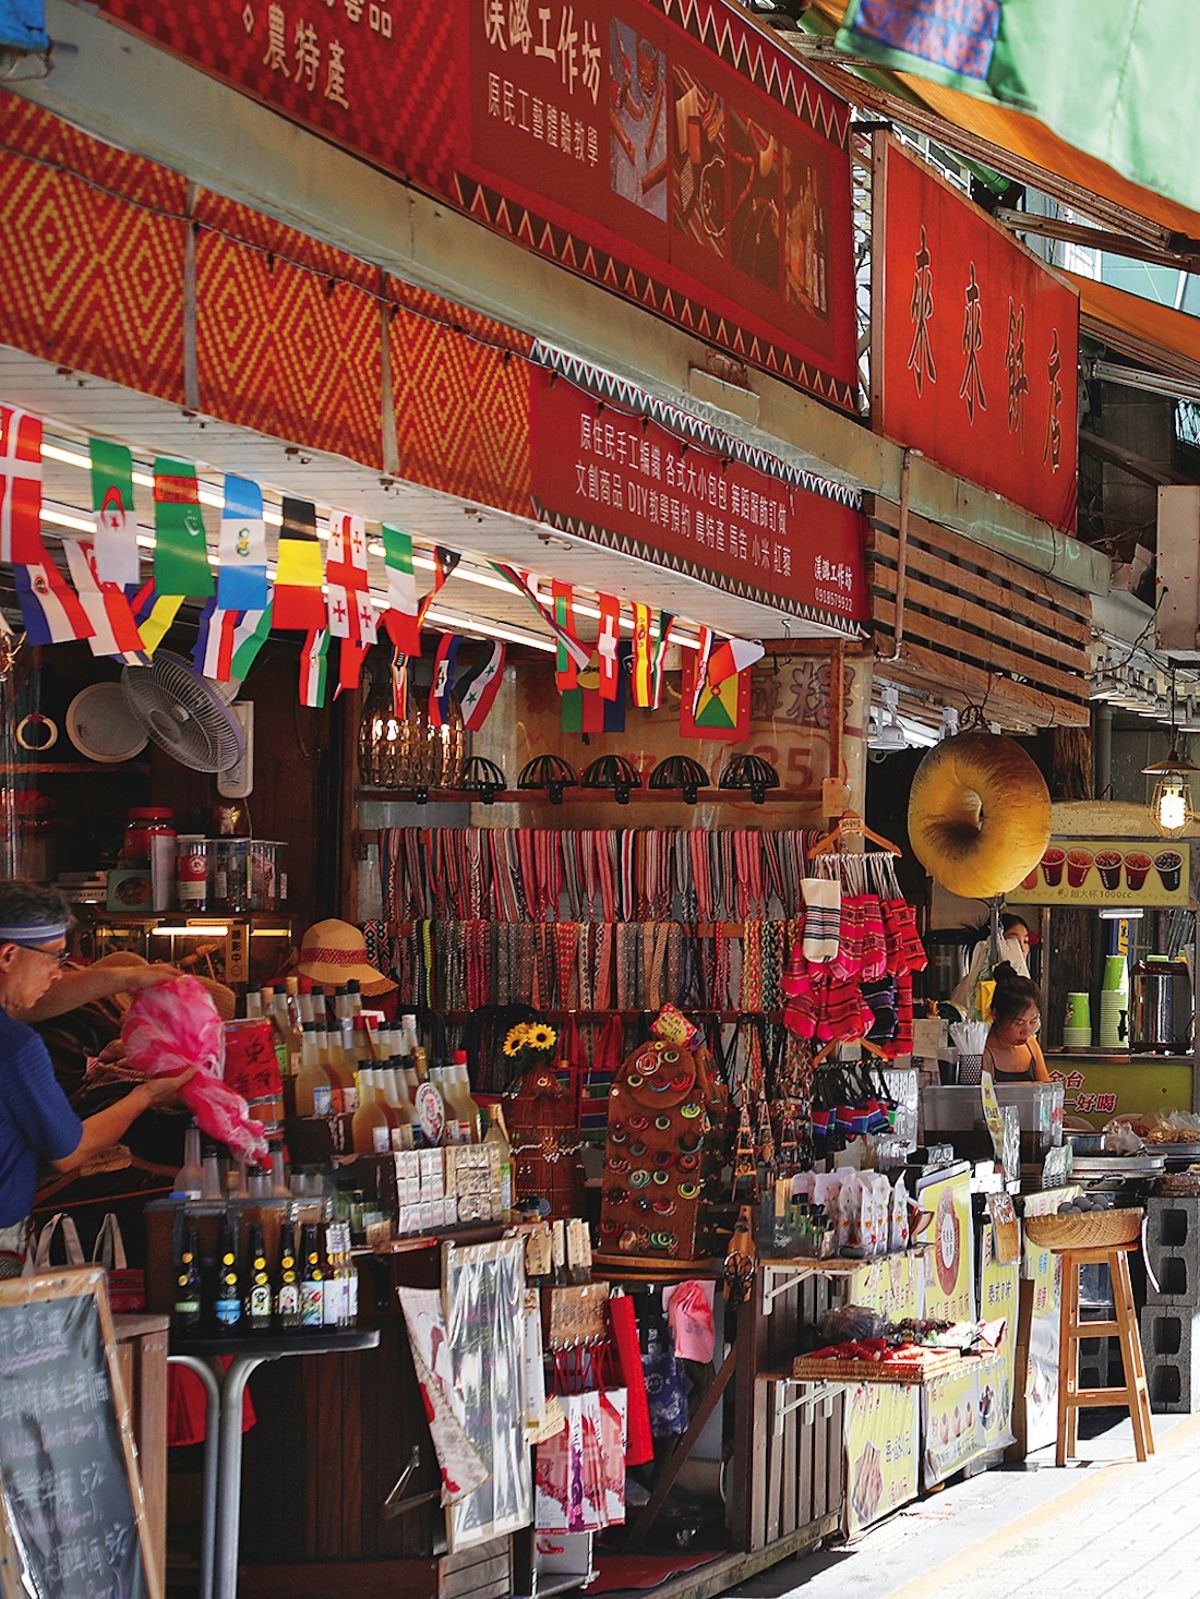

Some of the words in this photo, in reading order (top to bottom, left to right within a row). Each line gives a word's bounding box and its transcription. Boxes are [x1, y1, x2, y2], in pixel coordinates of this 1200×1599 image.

[263, 3, 350, 110] 農特產
[488, 71, 599, 168] 原民工藝體驗教學
[907, 224, 1062, 475] 來來餅店
[575, 459, 624, 511] 文創商品
[627, 480, 692, 539] DIY教學預約
[695, 510, 726, 553] 農特產
[729, 523, 748, 562] 馬告
[752, 534, 771, 570] 小米
[774, 542, 793, 577] 紅藜
[580, 413, 662, 482] 原住民手工編織
[665, 451, 728, 511] 各式大小包包
[731, 482, 788, 535] 舞蹈服飾訂做
